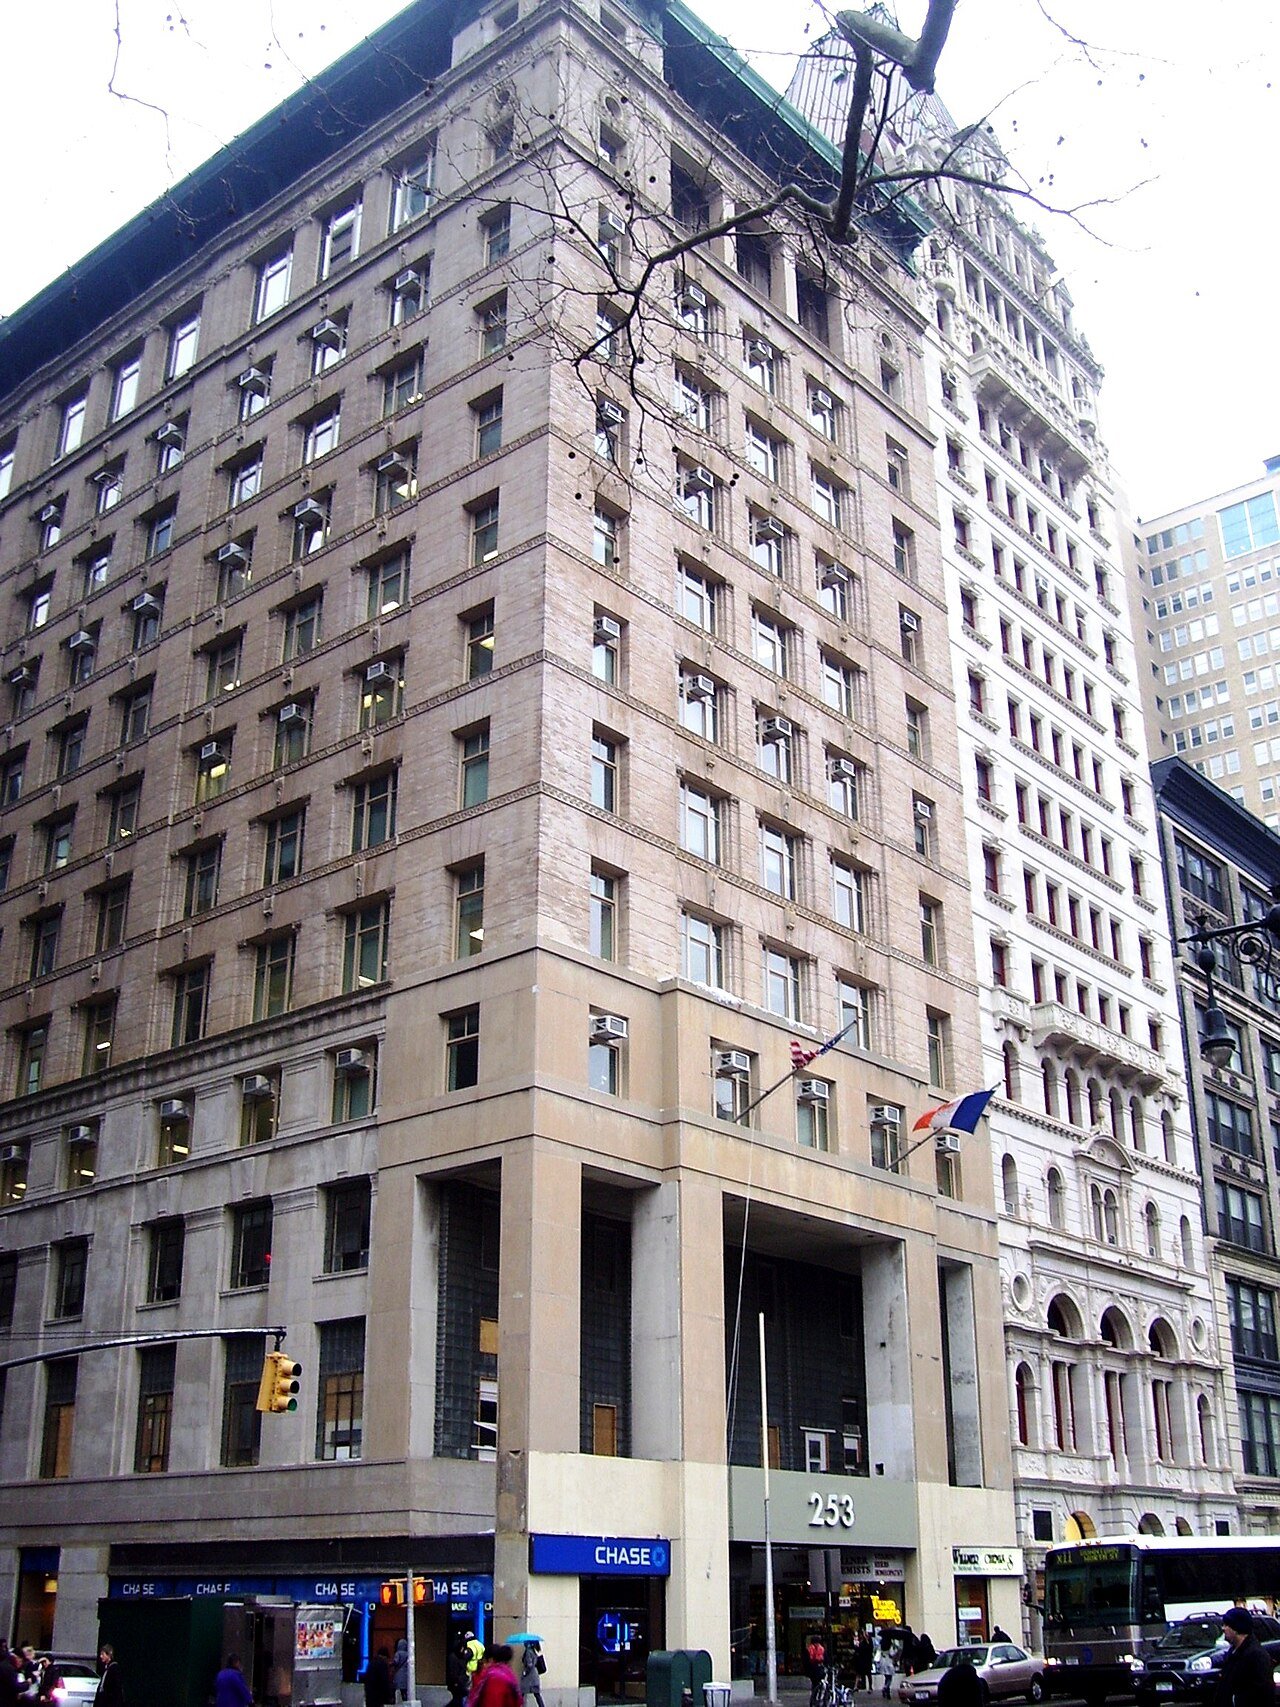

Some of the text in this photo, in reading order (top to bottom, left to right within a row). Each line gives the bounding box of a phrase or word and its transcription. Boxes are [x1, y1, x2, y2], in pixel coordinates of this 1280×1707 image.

[808, 1492, 855, 1528] 253
[595, 1546, 651, 1566] CHASE
[123, 1584, 155, 1595] CHASE
[315, 1583, 356, 1596] CHASE
[433, 1581, 468, 1595] HASE
